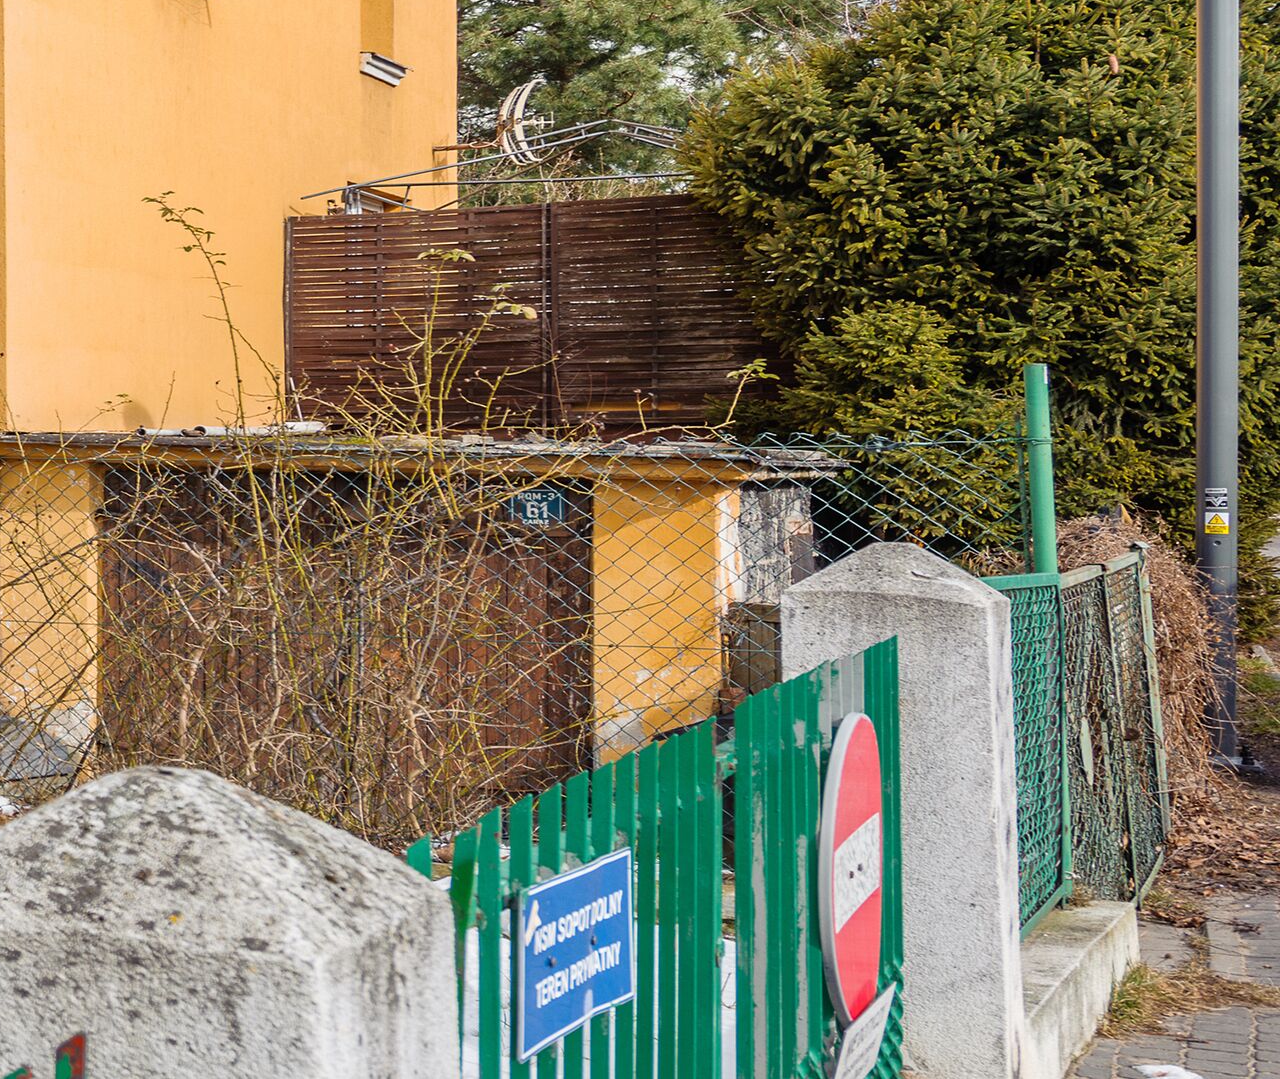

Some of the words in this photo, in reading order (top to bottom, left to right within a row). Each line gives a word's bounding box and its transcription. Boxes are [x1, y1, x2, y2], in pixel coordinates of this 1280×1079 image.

[526, 501, 548, 519] 61
[557, 904, 592, 943] SOPOT
[590, 889, 623, 926] DOLNY
[535, 968, 569, 1009] TEREN
[569, 941, 621, 990] PRYWATNY
